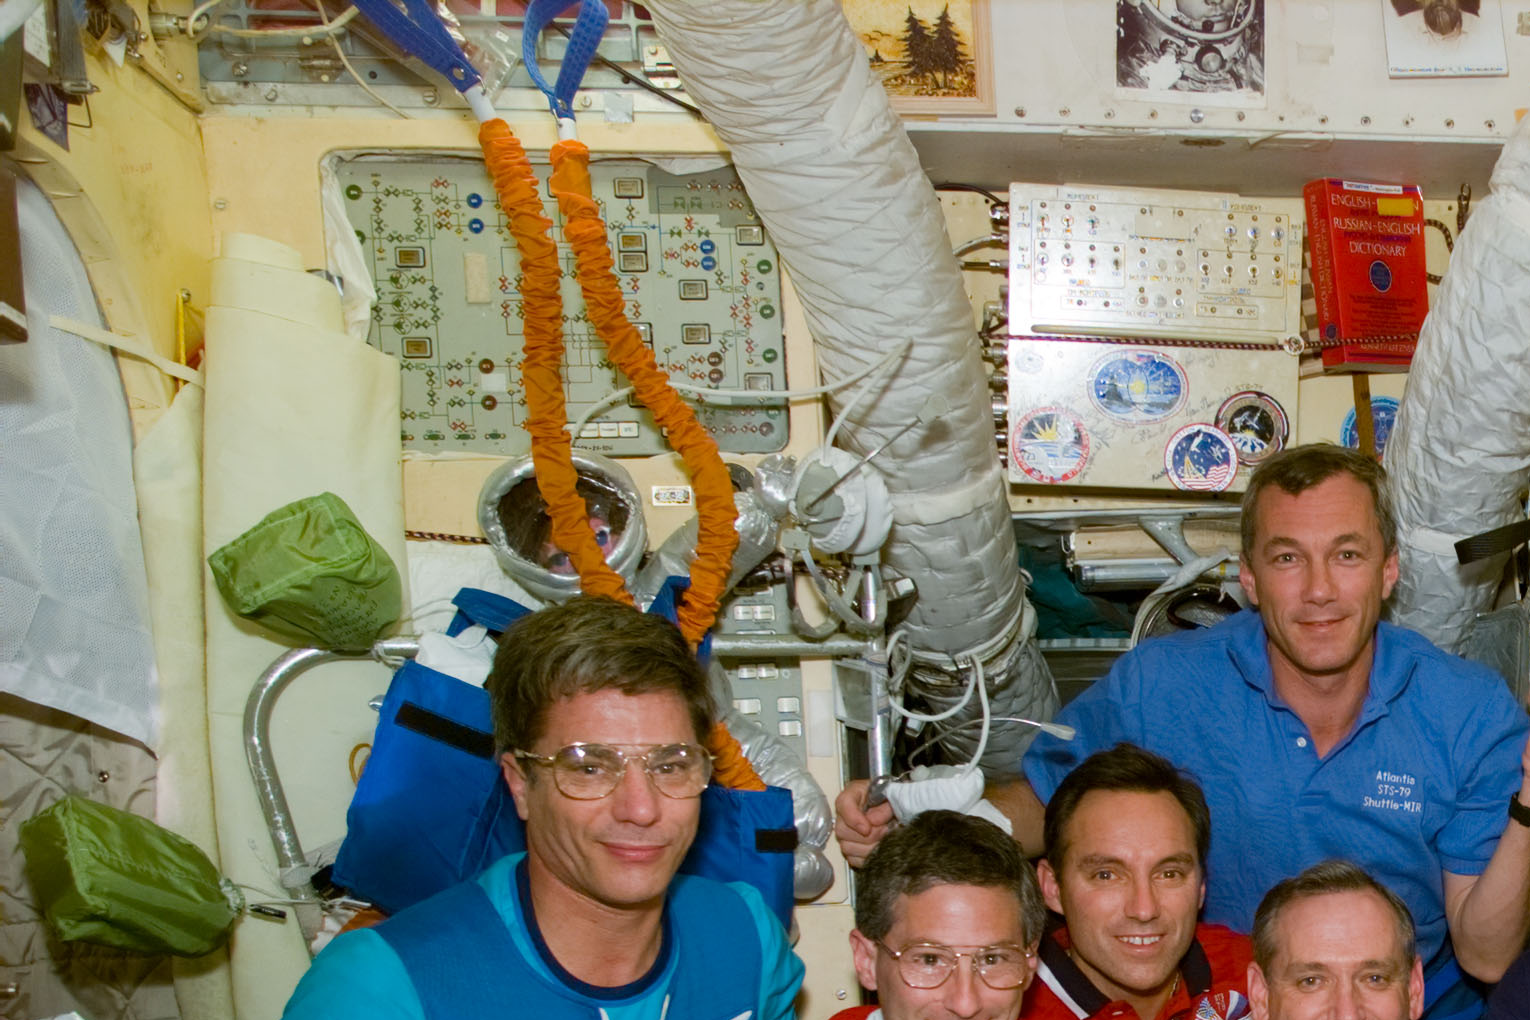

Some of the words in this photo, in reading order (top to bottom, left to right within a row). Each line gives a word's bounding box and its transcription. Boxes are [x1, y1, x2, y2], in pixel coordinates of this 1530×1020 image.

[1333, 216, 1420, 236] RUSSIAN-ENGLISH
[1349, 241, 1406, 256] DICTIONARY
[1376, 770, 1416, 785] Atlantis
[1377, 784, 1412, 797] STS-79
[1363, 795, 1422, 812] Shuttle-MIR
